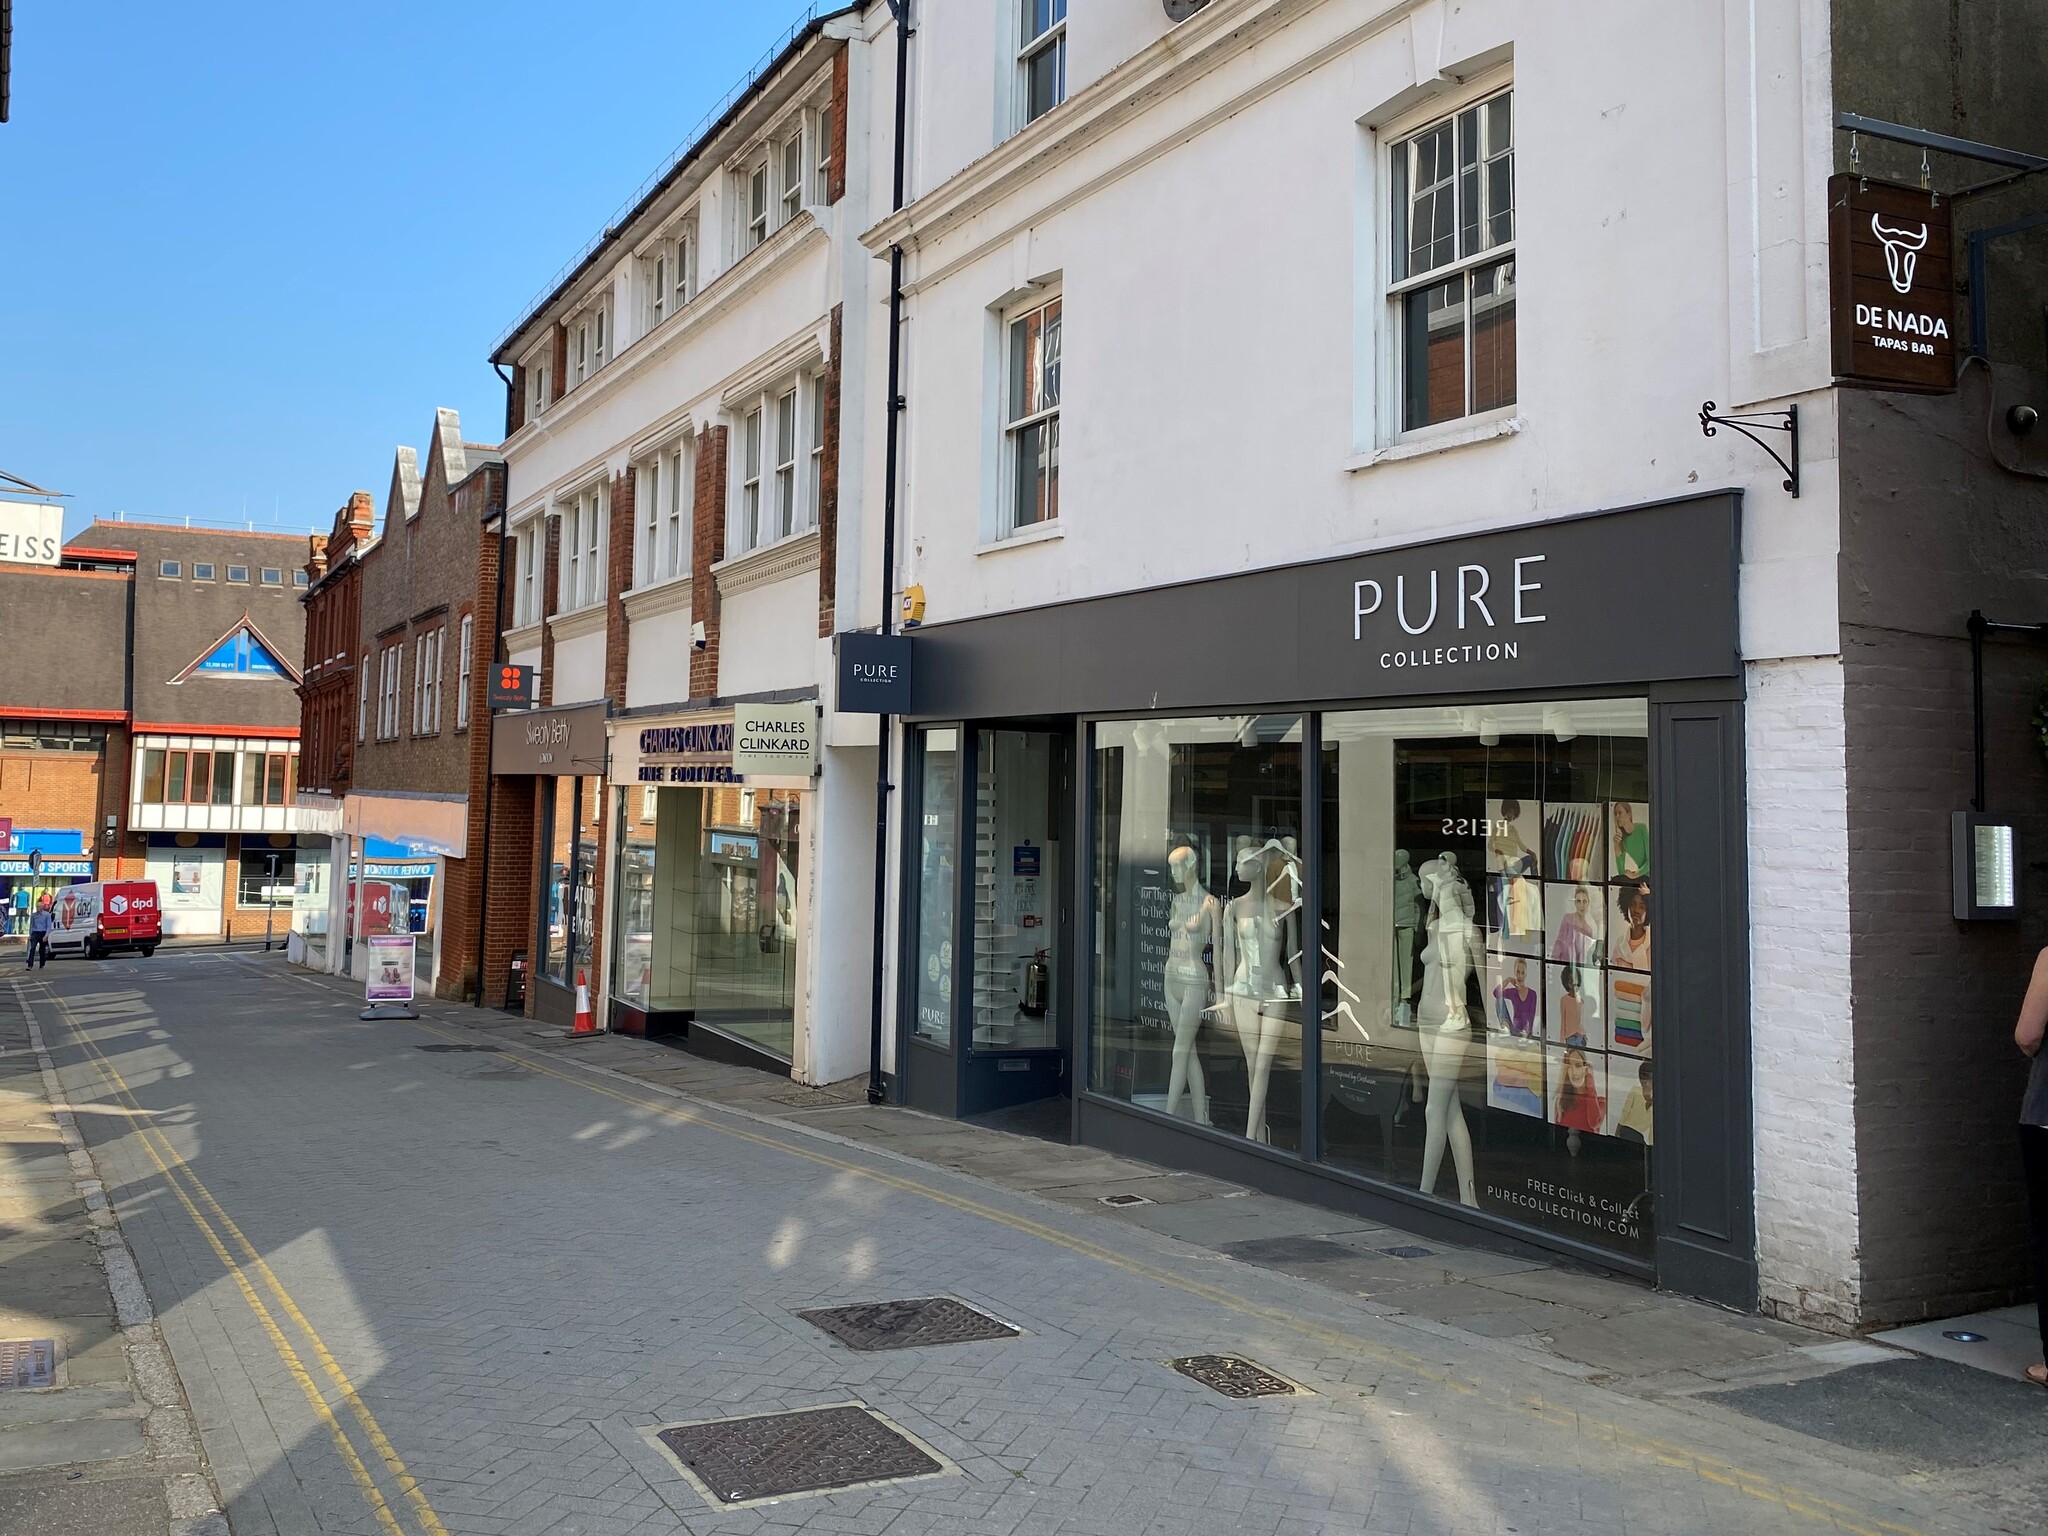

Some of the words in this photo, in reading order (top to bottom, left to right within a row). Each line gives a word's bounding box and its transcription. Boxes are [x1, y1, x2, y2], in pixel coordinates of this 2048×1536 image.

[1855, 303, 1883, 329] DE
[1887, 309, 1949, 340] NADA
[1871, 335, 1908, 352] TAPAS
[1911, 342, 1935, 356] BAR
[1354, 554, 1547, 640] PURE
[1380, 641, 1518, 669] COLLECTION
[853, 663, 898, 678] PURE
[526, 720, 551, 750] Sweaty
[551, 718, 571, 749] Betty
[745, 720, 805, 734] CHARLES
[639, 727, 680, 754] CHARLES
[739, 738, 810, 751] CLINKARD
[638, 766, 664, 782] FINE
[0, 862, 30, 873] OVER
[47, 862, 89, 873] SPORTS
[131, 897, 154, 911] dpd
[1150, 905, 1164, 919] the
[1140, 922, 1154, 936] the
[1140, 940, 1154, 954] the
[1140, 978, 1163, 992] setter
[922, 1006, 945, 1025] PURE
[1140, 1015, 1159, 1029] your
[1160, 1019, 1173, 1032] wa
[1335, 1040, 1373, 1062] PURE
[1527, 1178, 1555, 1196] FREE
[1558, 1187, 1585, 1205] Click
[1589, 1195, 1597, 1208] &
[1600, 1199, 1640, 1220] Collect
[1487, 1185, 1641, 1240] PURECOLLECTION.COM
